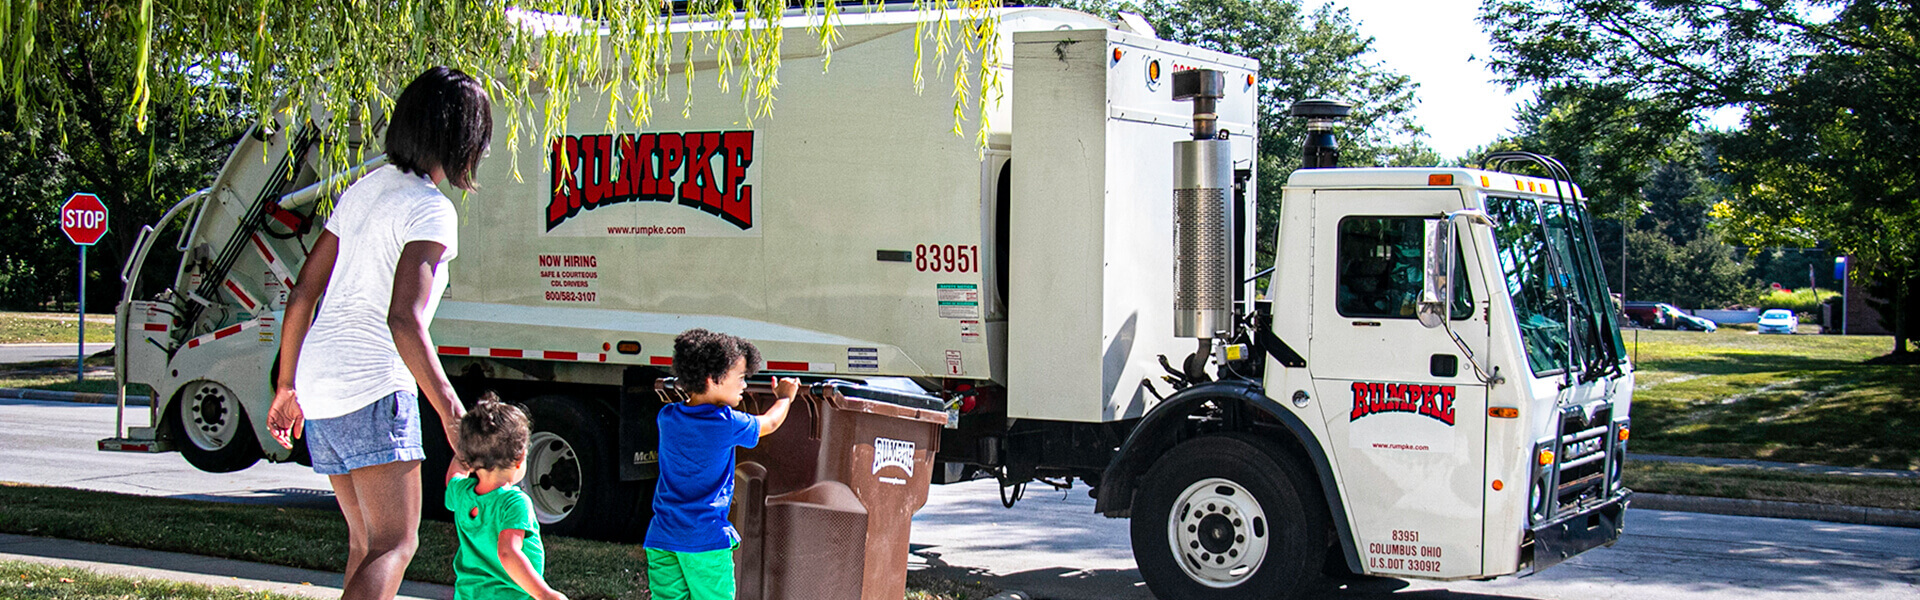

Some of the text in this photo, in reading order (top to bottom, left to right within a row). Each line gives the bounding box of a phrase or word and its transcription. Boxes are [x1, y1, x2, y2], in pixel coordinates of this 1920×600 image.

[546, 131, 754, 233] RUMPKE
[65, 209, 105, 229] STOP
[607, 225, 686, 236] www.rumpke.com
[539, 255, 597, 268] NOW HIRING
[915, 244, 978, 273] 83951
[561, 271, 598, 279] COURTEOUS
[563, 280, 589, 288] DRIVERS
[545, 291, 596, 302] 800/582-3107
[1350, 382, 1456, 426] RUMPKE
[1372, 442, 1430, 451] www.rumpke.com
[1392, 530, 1419, 542] 83951
[1369, 543, 1442, 558] COLUMBUS OHIO
[1370, 557, 1441, 572] U.S.DOT 330912
